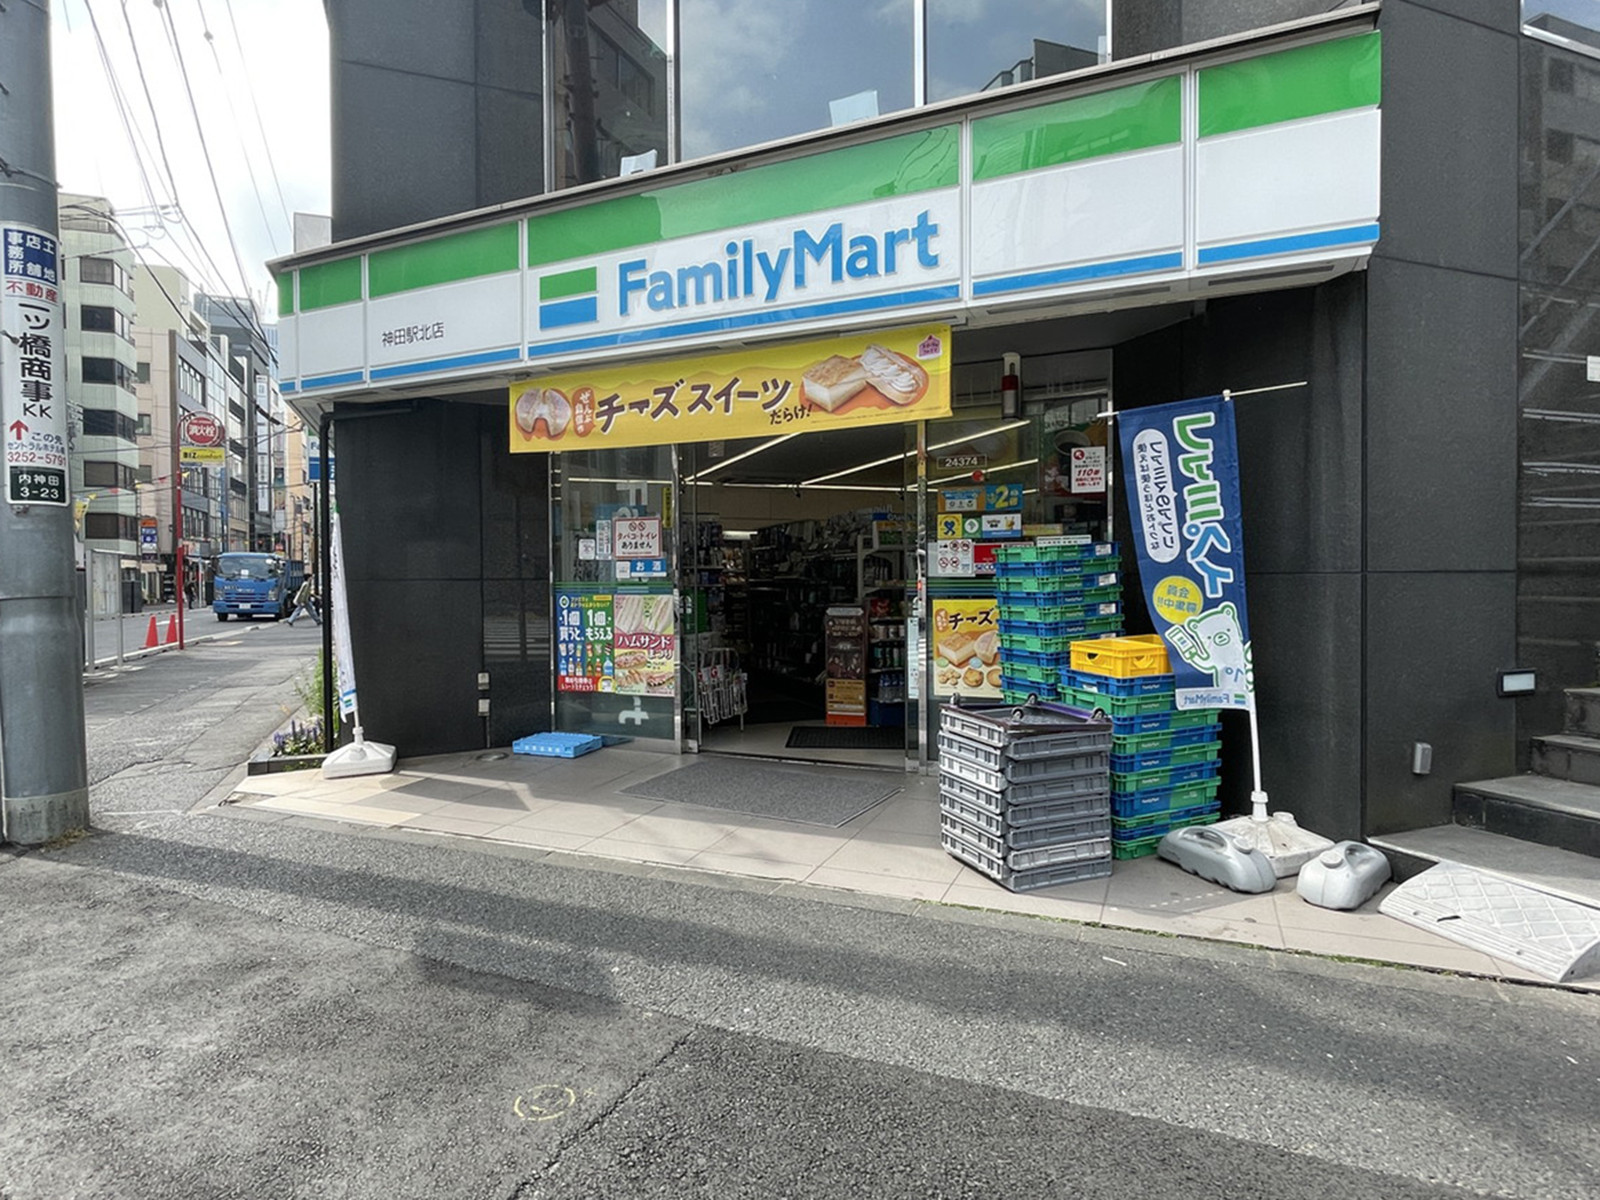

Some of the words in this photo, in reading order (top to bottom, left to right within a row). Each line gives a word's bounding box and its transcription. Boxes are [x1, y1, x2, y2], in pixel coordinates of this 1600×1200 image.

[7, 231, 24, 274] 事務所
[26, 234, 42, 277] 店舗
[42, 240, 56, 282] 土地
[617, 210, 940, 319] FamilyMart
[6, 280, 58, 303] 不動産
[381, 322, 444, 348] 神田駅北店
[18, 302, 53, 402] 一ツ橋商事
[31, 432, 63, 445] この先
[189, 425, 215, 437] 消火栓
[944, 456, 978, 467] 24374
[18, 474, 60, 486] 内神田
[20, 486, 59, 499] 3-23
[949, 607, 994, 630] チーズ
[617, 635, 670, 649] ハムサンド
